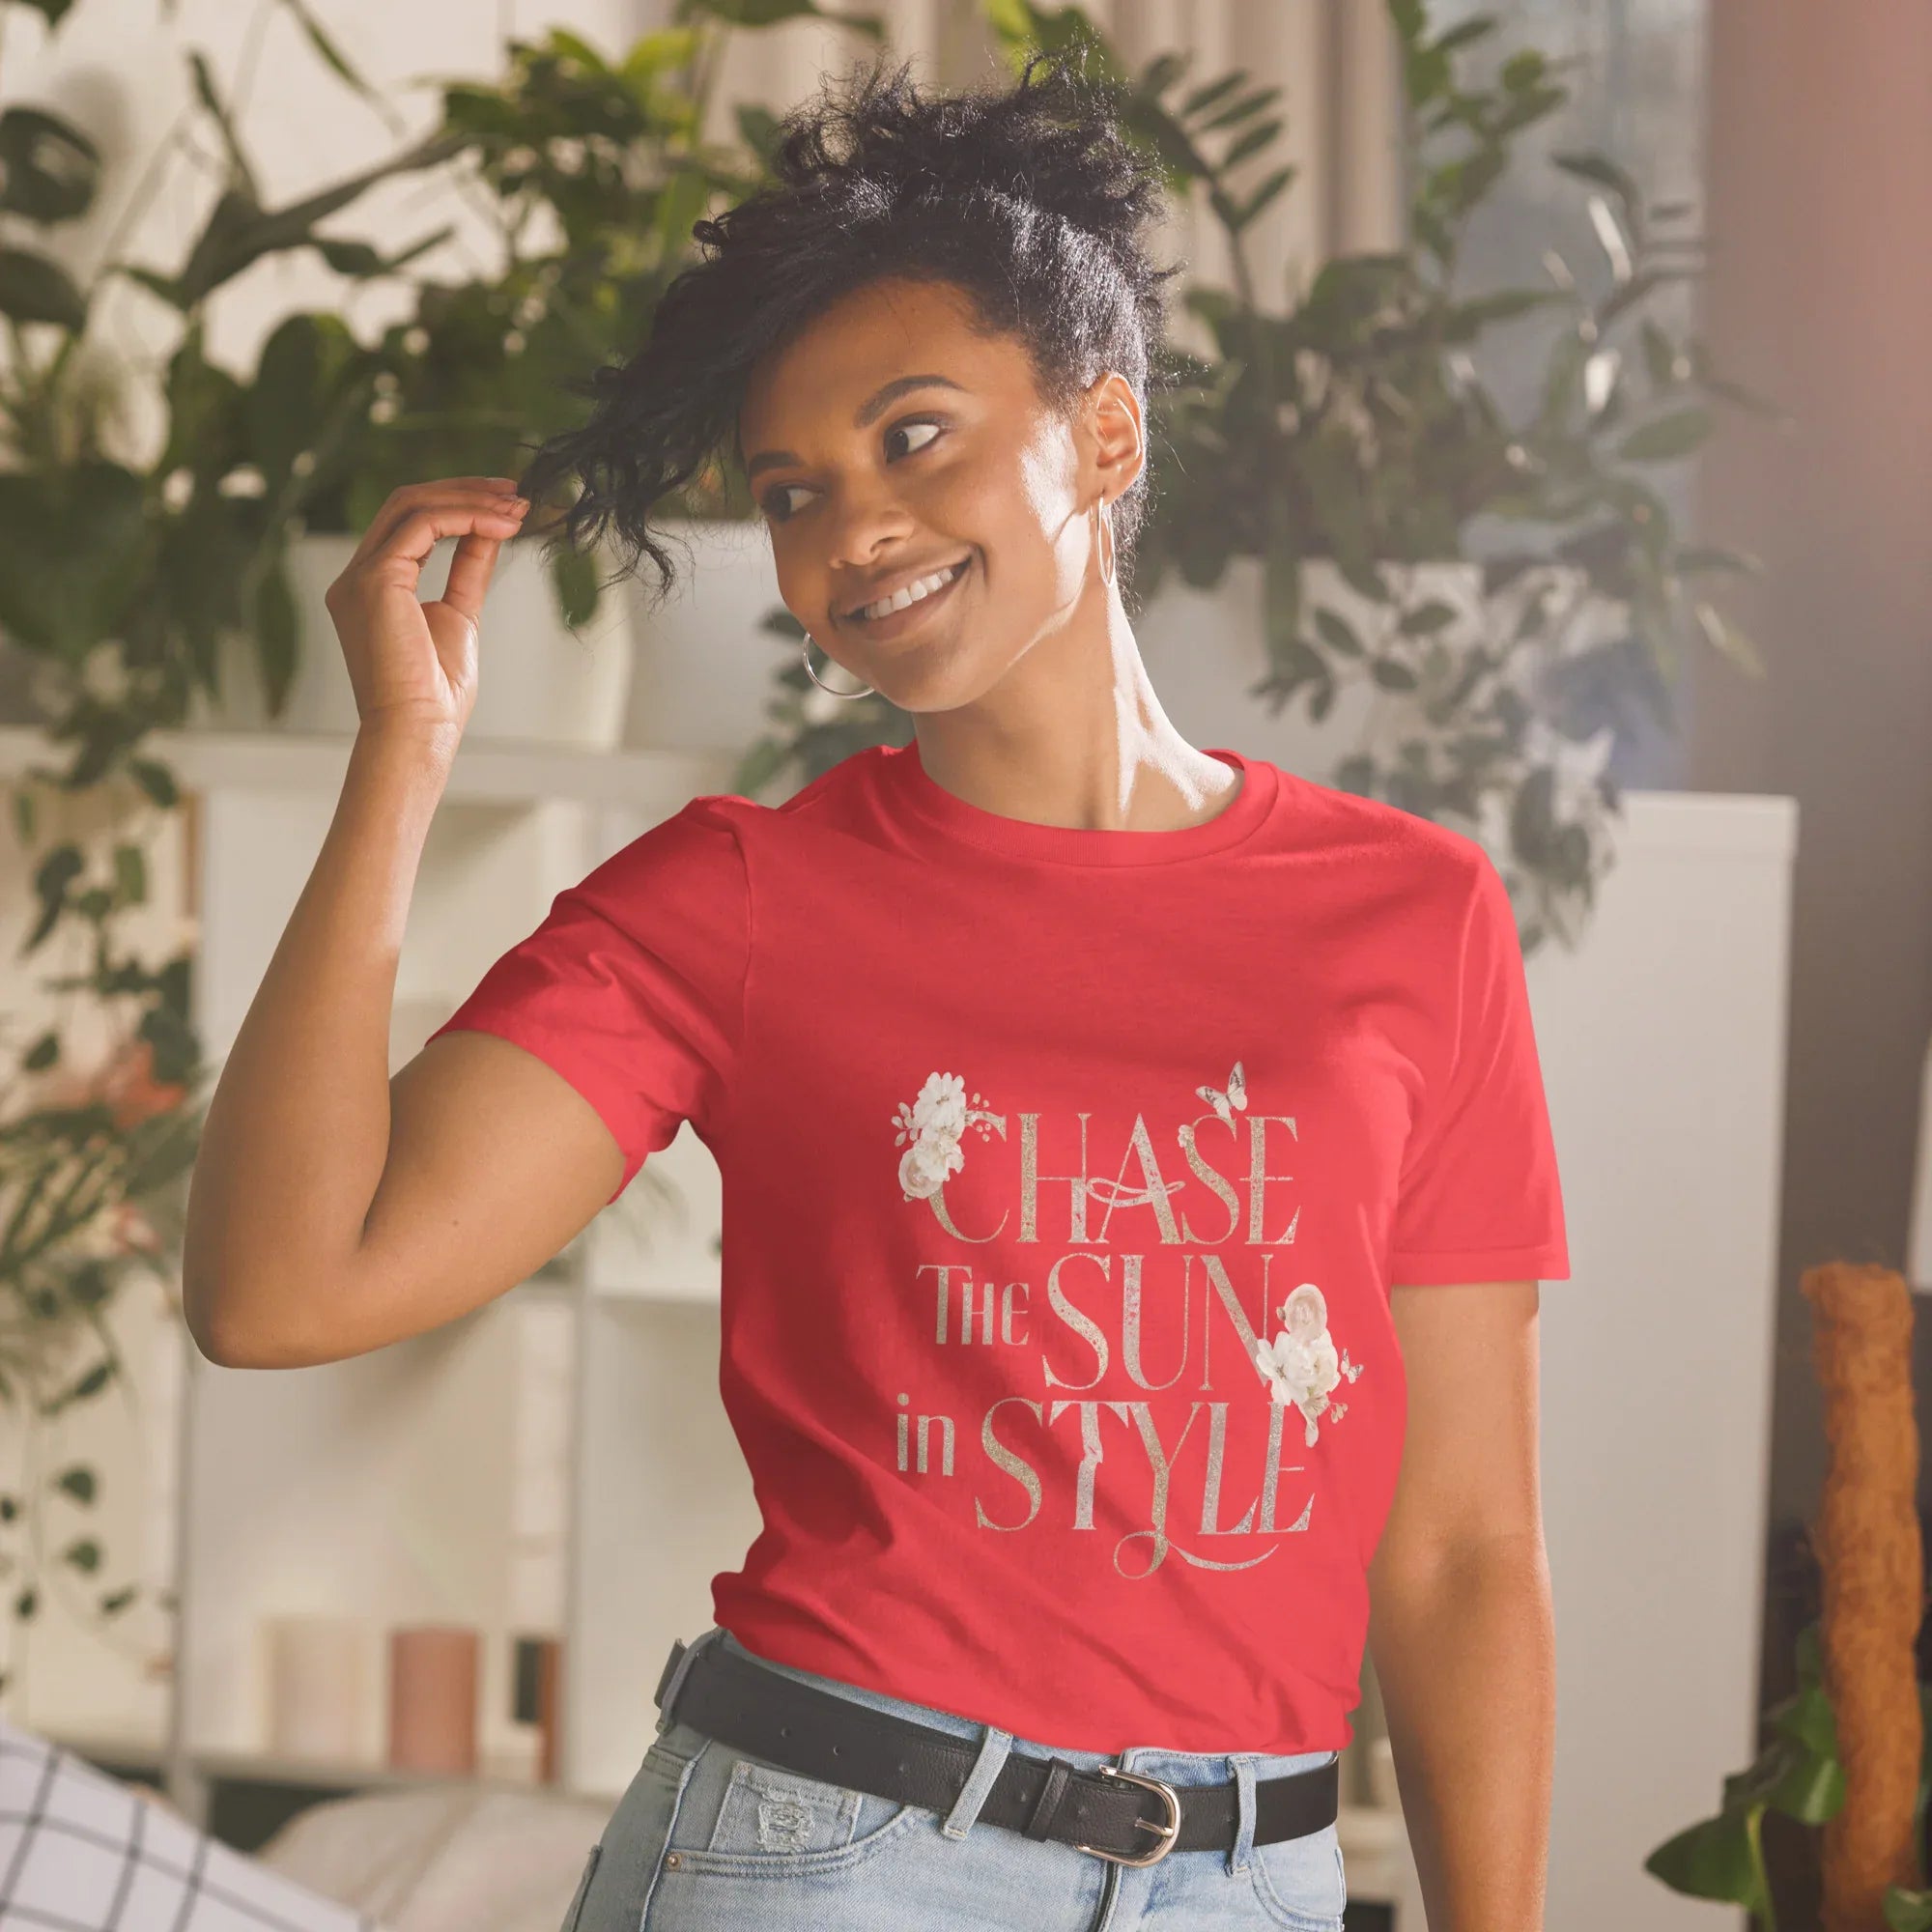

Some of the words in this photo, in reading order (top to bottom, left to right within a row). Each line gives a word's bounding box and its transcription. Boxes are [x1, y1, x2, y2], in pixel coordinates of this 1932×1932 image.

[926, 1112, 1301, 1244] CHASE
[1041, 1252, 1274, 1391] SUN
[895, 1392, 954, 1476] in
[974, 1397, 1316, 1579] STYLE
